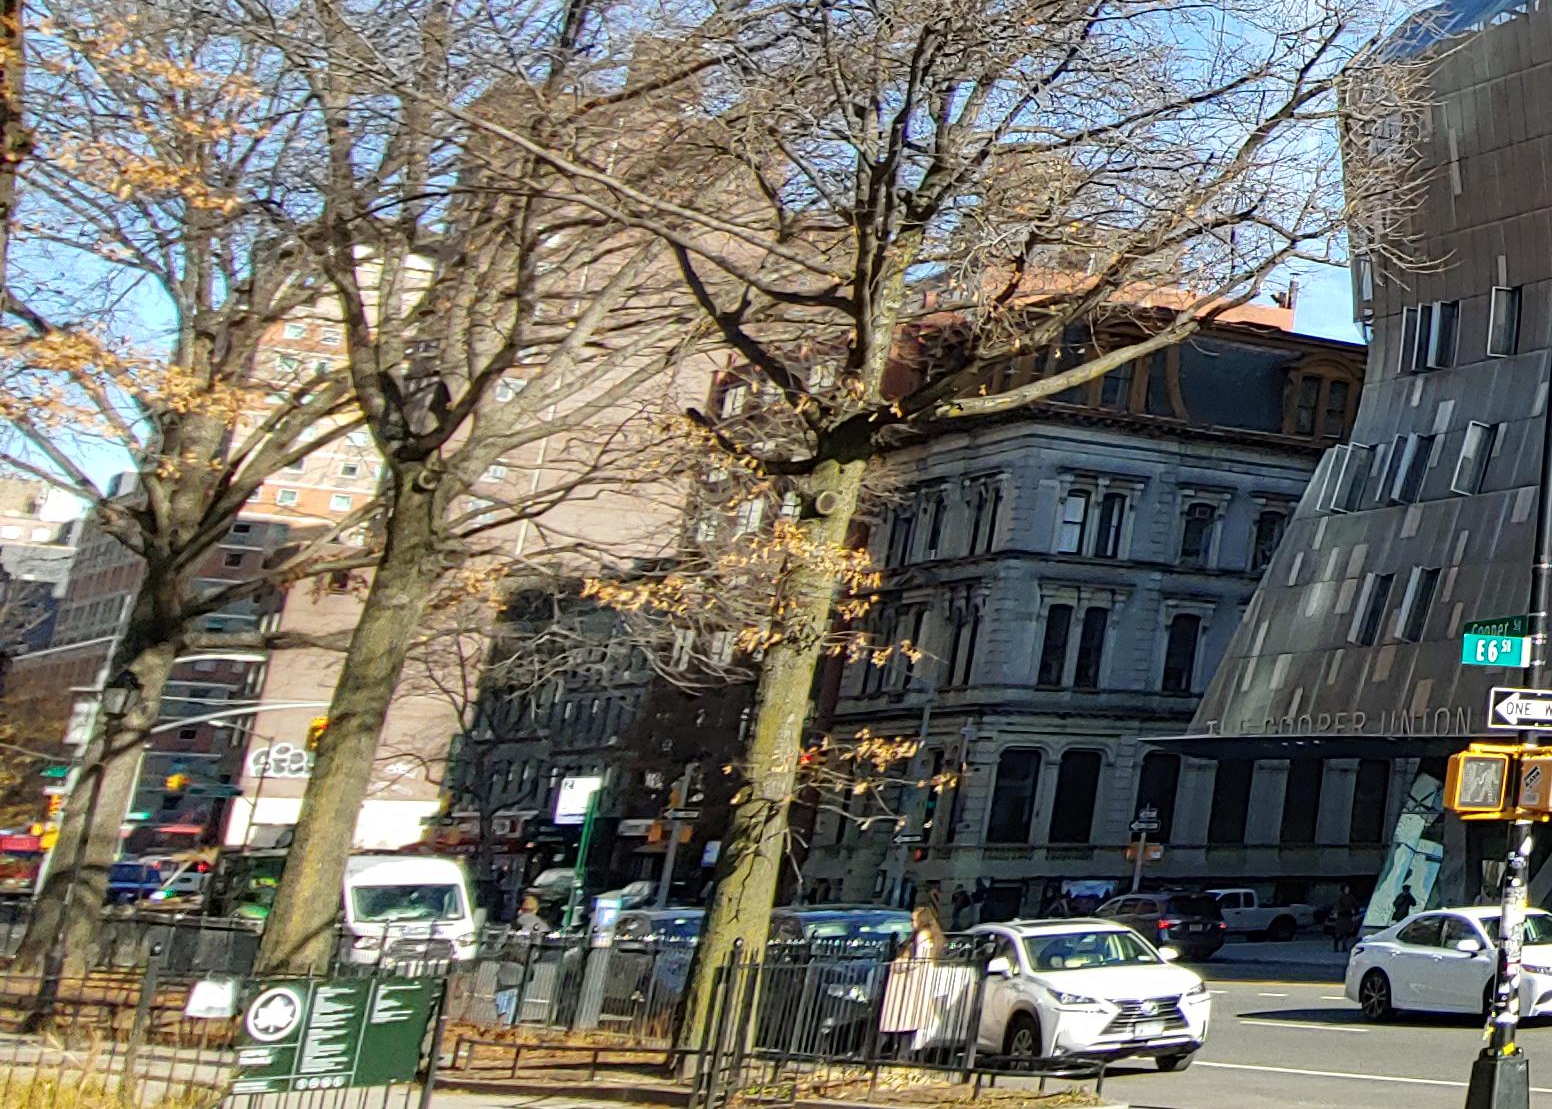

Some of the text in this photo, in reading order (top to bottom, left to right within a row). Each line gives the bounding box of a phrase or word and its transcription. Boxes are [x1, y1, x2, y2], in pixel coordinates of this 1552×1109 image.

[1506, 701, 1531, 715] ONE
[1264, 711, 1366, 735] COOPER
[1381, 706, 1472, 735] UNION
